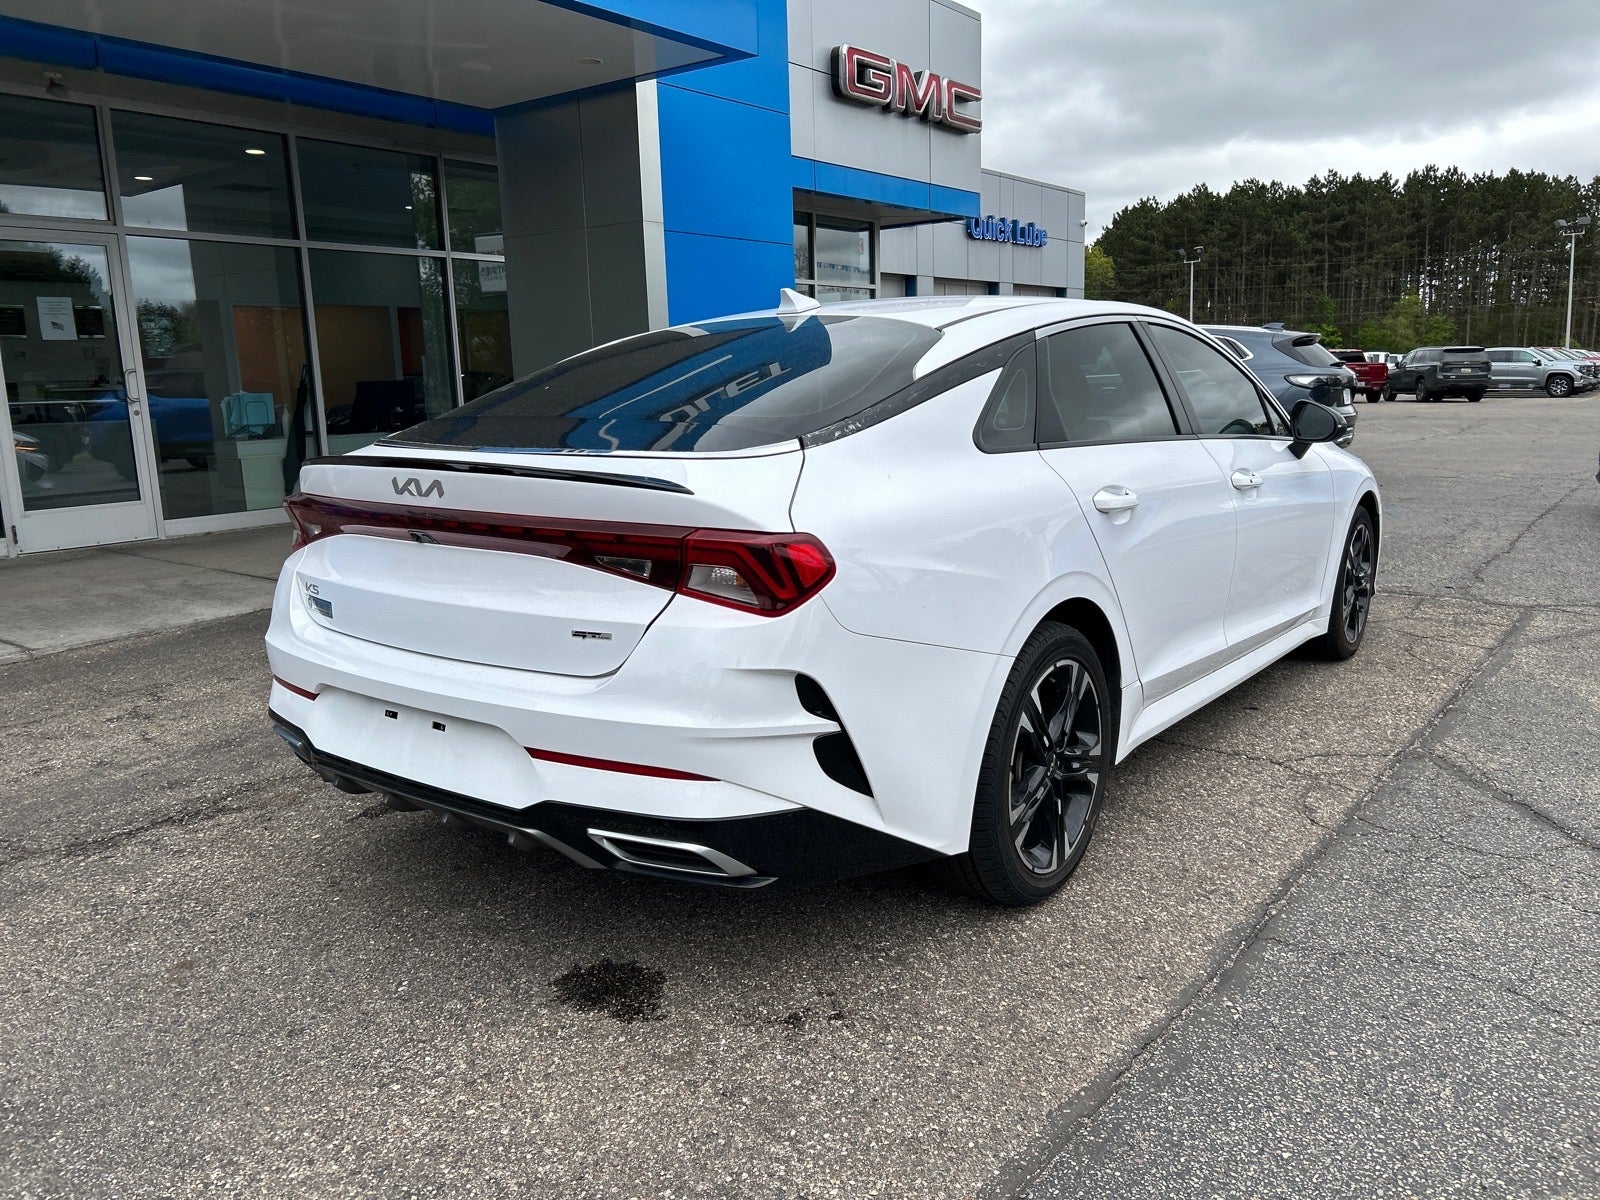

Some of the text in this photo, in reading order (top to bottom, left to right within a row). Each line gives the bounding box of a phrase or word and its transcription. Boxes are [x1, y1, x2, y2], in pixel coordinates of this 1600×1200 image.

[831, 43, 982, 134] GMC
[967, 215, 1013, 242] Quick
[391, 476, 445, 499] KIA
